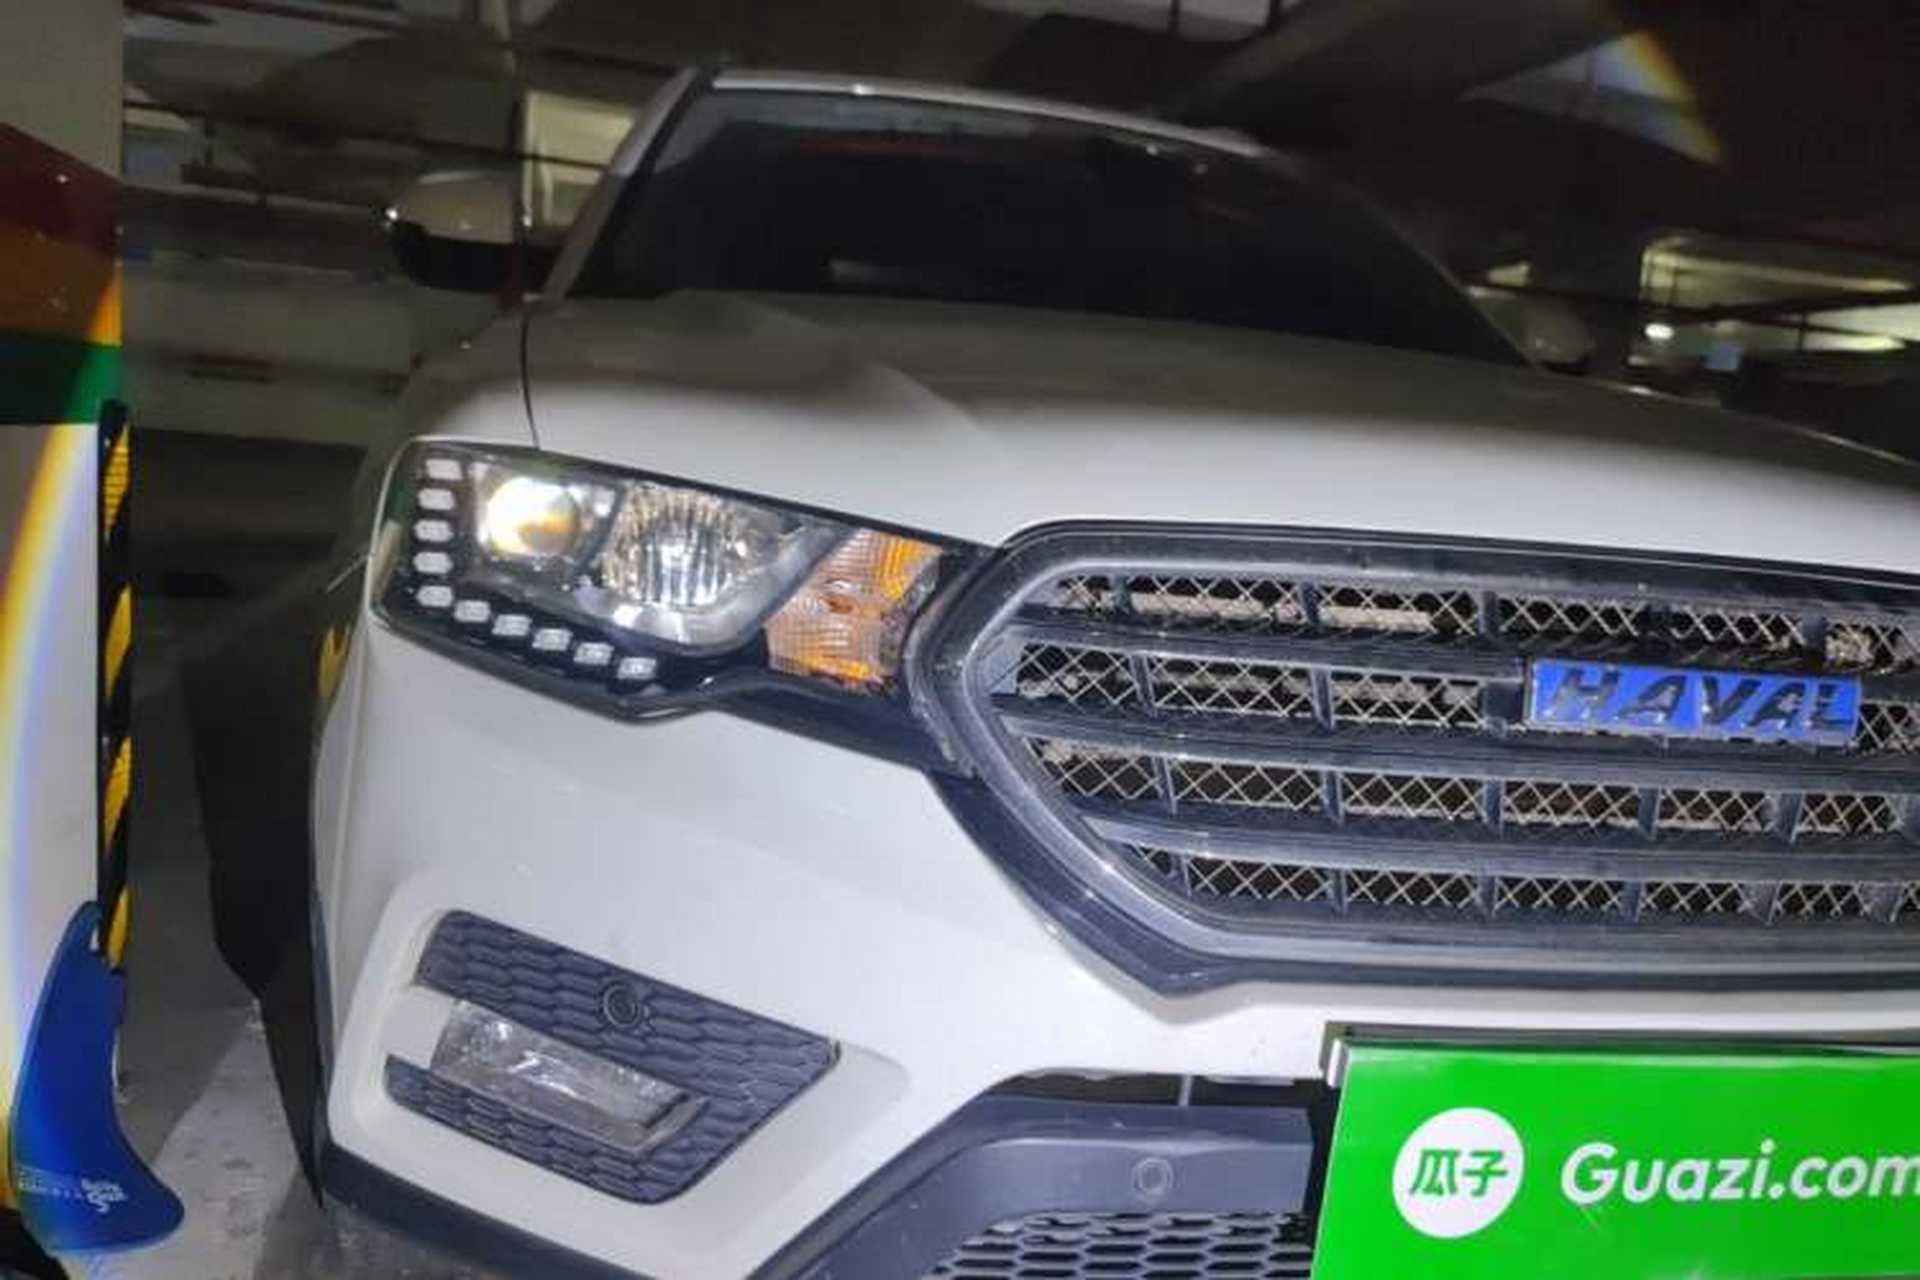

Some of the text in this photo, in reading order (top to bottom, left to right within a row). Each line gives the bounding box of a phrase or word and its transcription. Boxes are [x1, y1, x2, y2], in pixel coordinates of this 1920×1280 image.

[1542, 666, 1854, 731] HAVAL
[1409, 1148, 1509, 1197] 瓜子
[1561, 1138, 1920, 1206] Guazi.com
